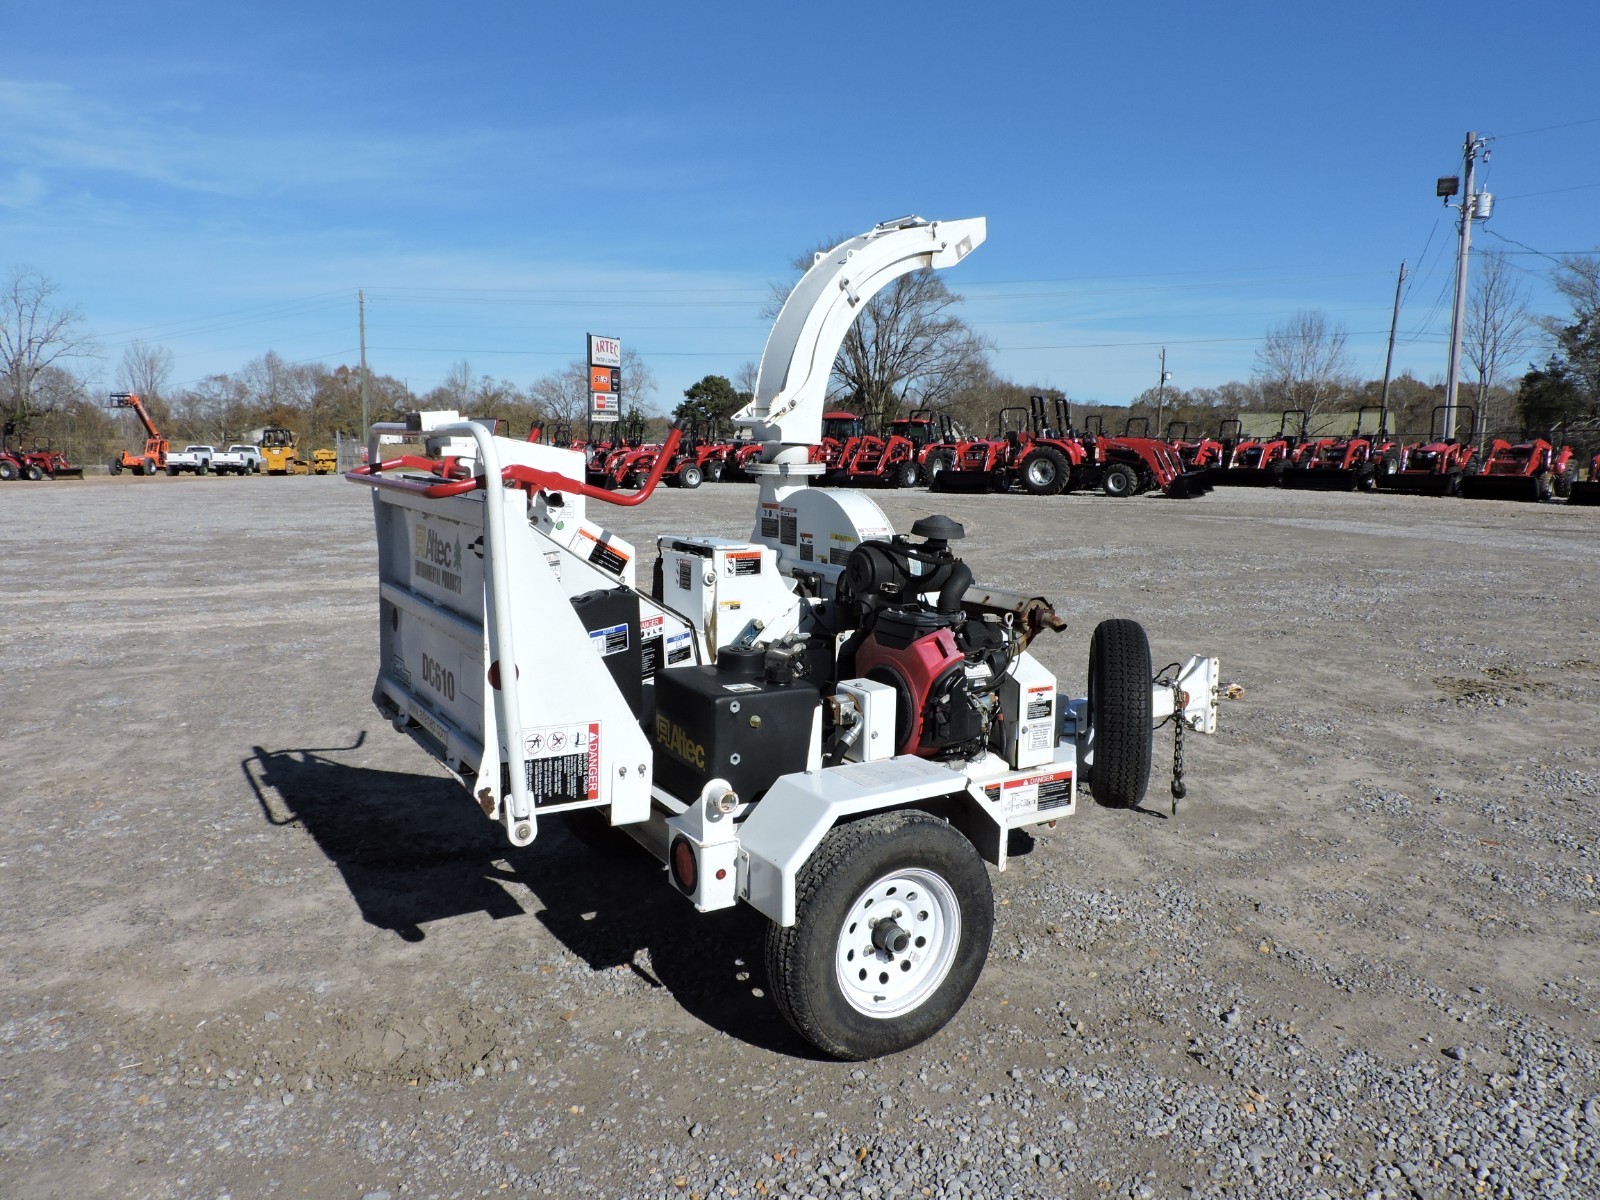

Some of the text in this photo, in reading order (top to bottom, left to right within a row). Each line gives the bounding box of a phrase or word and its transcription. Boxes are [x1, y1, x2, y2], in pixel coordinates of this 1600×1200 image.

[596, 340, 619, 357] ARTEC
[425, 528, 452, 568] Altec
[640, 618, 659, 630] ANGER
[422, 652, 455, 702] DC610
[588, 742, 598, 791] DANGER
[669, 724, 705, 769] Altec
[1029, 774, 1054, 785] DANGER
